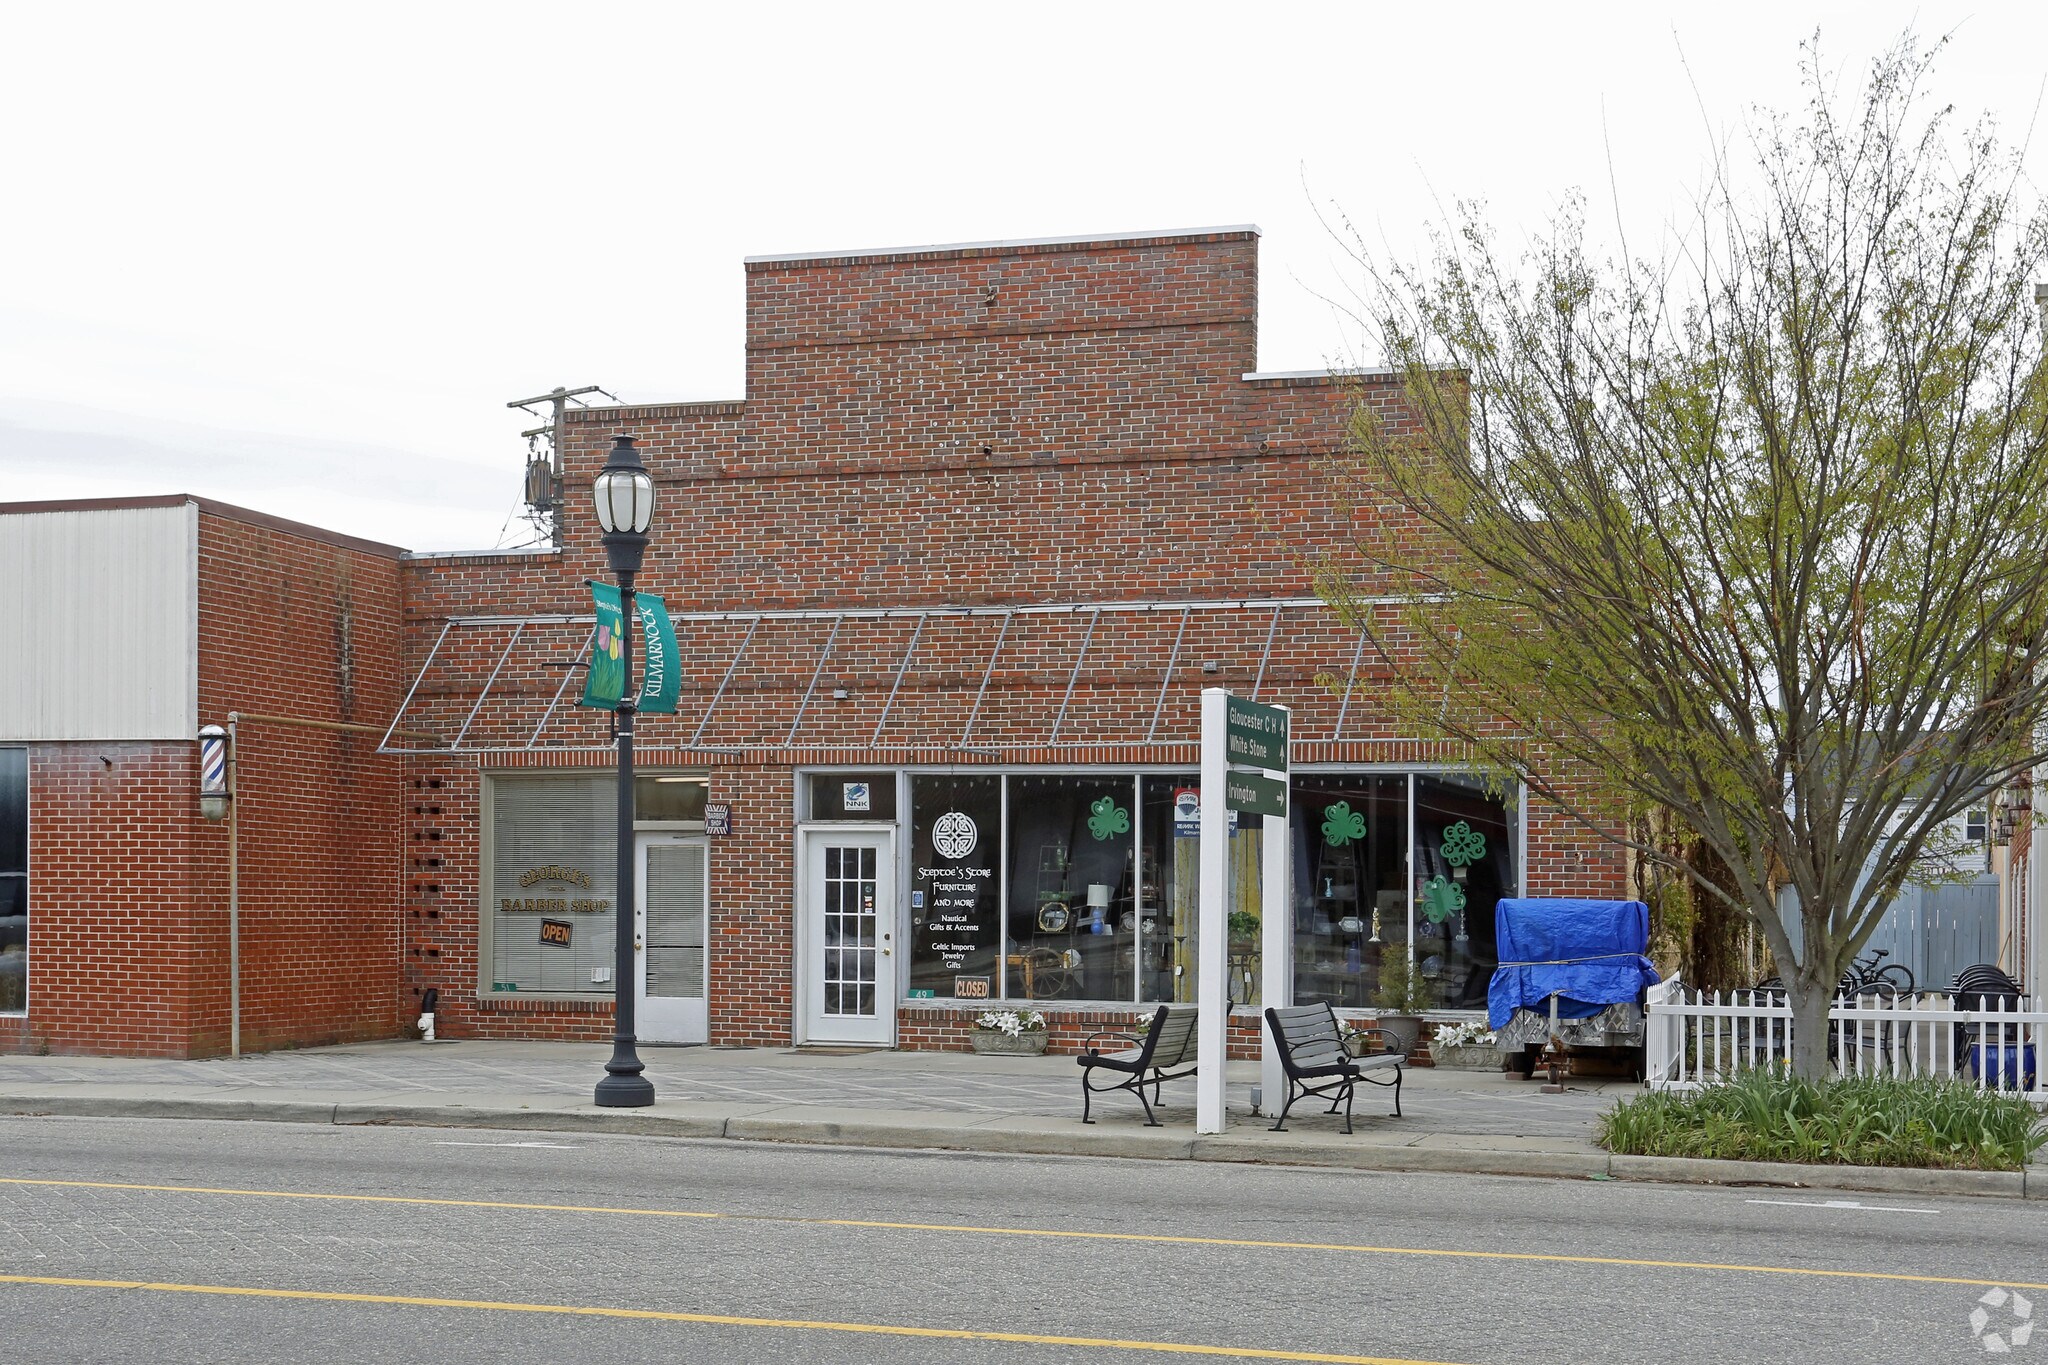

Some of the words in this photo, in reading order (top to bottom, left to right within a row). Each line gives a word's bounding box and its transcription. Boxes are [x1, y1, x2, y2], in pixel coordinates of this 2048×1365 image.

[640, 606, 664, 698] KILMARNOCK
[1229, 706, 1264, 732] Gloucester
[1265, 716, 1270, 733] C
[1271, 718, 1277, 734] H
[1229, 734, 1248, 754] White
[1249, 739, 1267, 759] Stone
[1228, 782, 1257, 804] Irvington
[710, 819, 722, 827] SHOP
[518, 865, 592, 890] GEORGE'S
[917, 866, 964, 880] Steptoe's
[964, 867, 992, 880] Store
[500, 899, 568, 912] BARBER
[571, 899, 609, 912] SHOP
[941, 914, 968, 922] Nautical
[542, 923, 570, 942] OPEN
[929, 923, 945, 931] Gifts
[954, 923, 979, 931] Accents
[931, 942, 950, 950] Celtic
[951, 943, 976, 951] Imports
[942, 951, 966, 960] Jewelry
[946, 961, 962, 969] Gifts
[915, 990, 928, 998] 49
[956, 980, 988, 997] CLOSED
